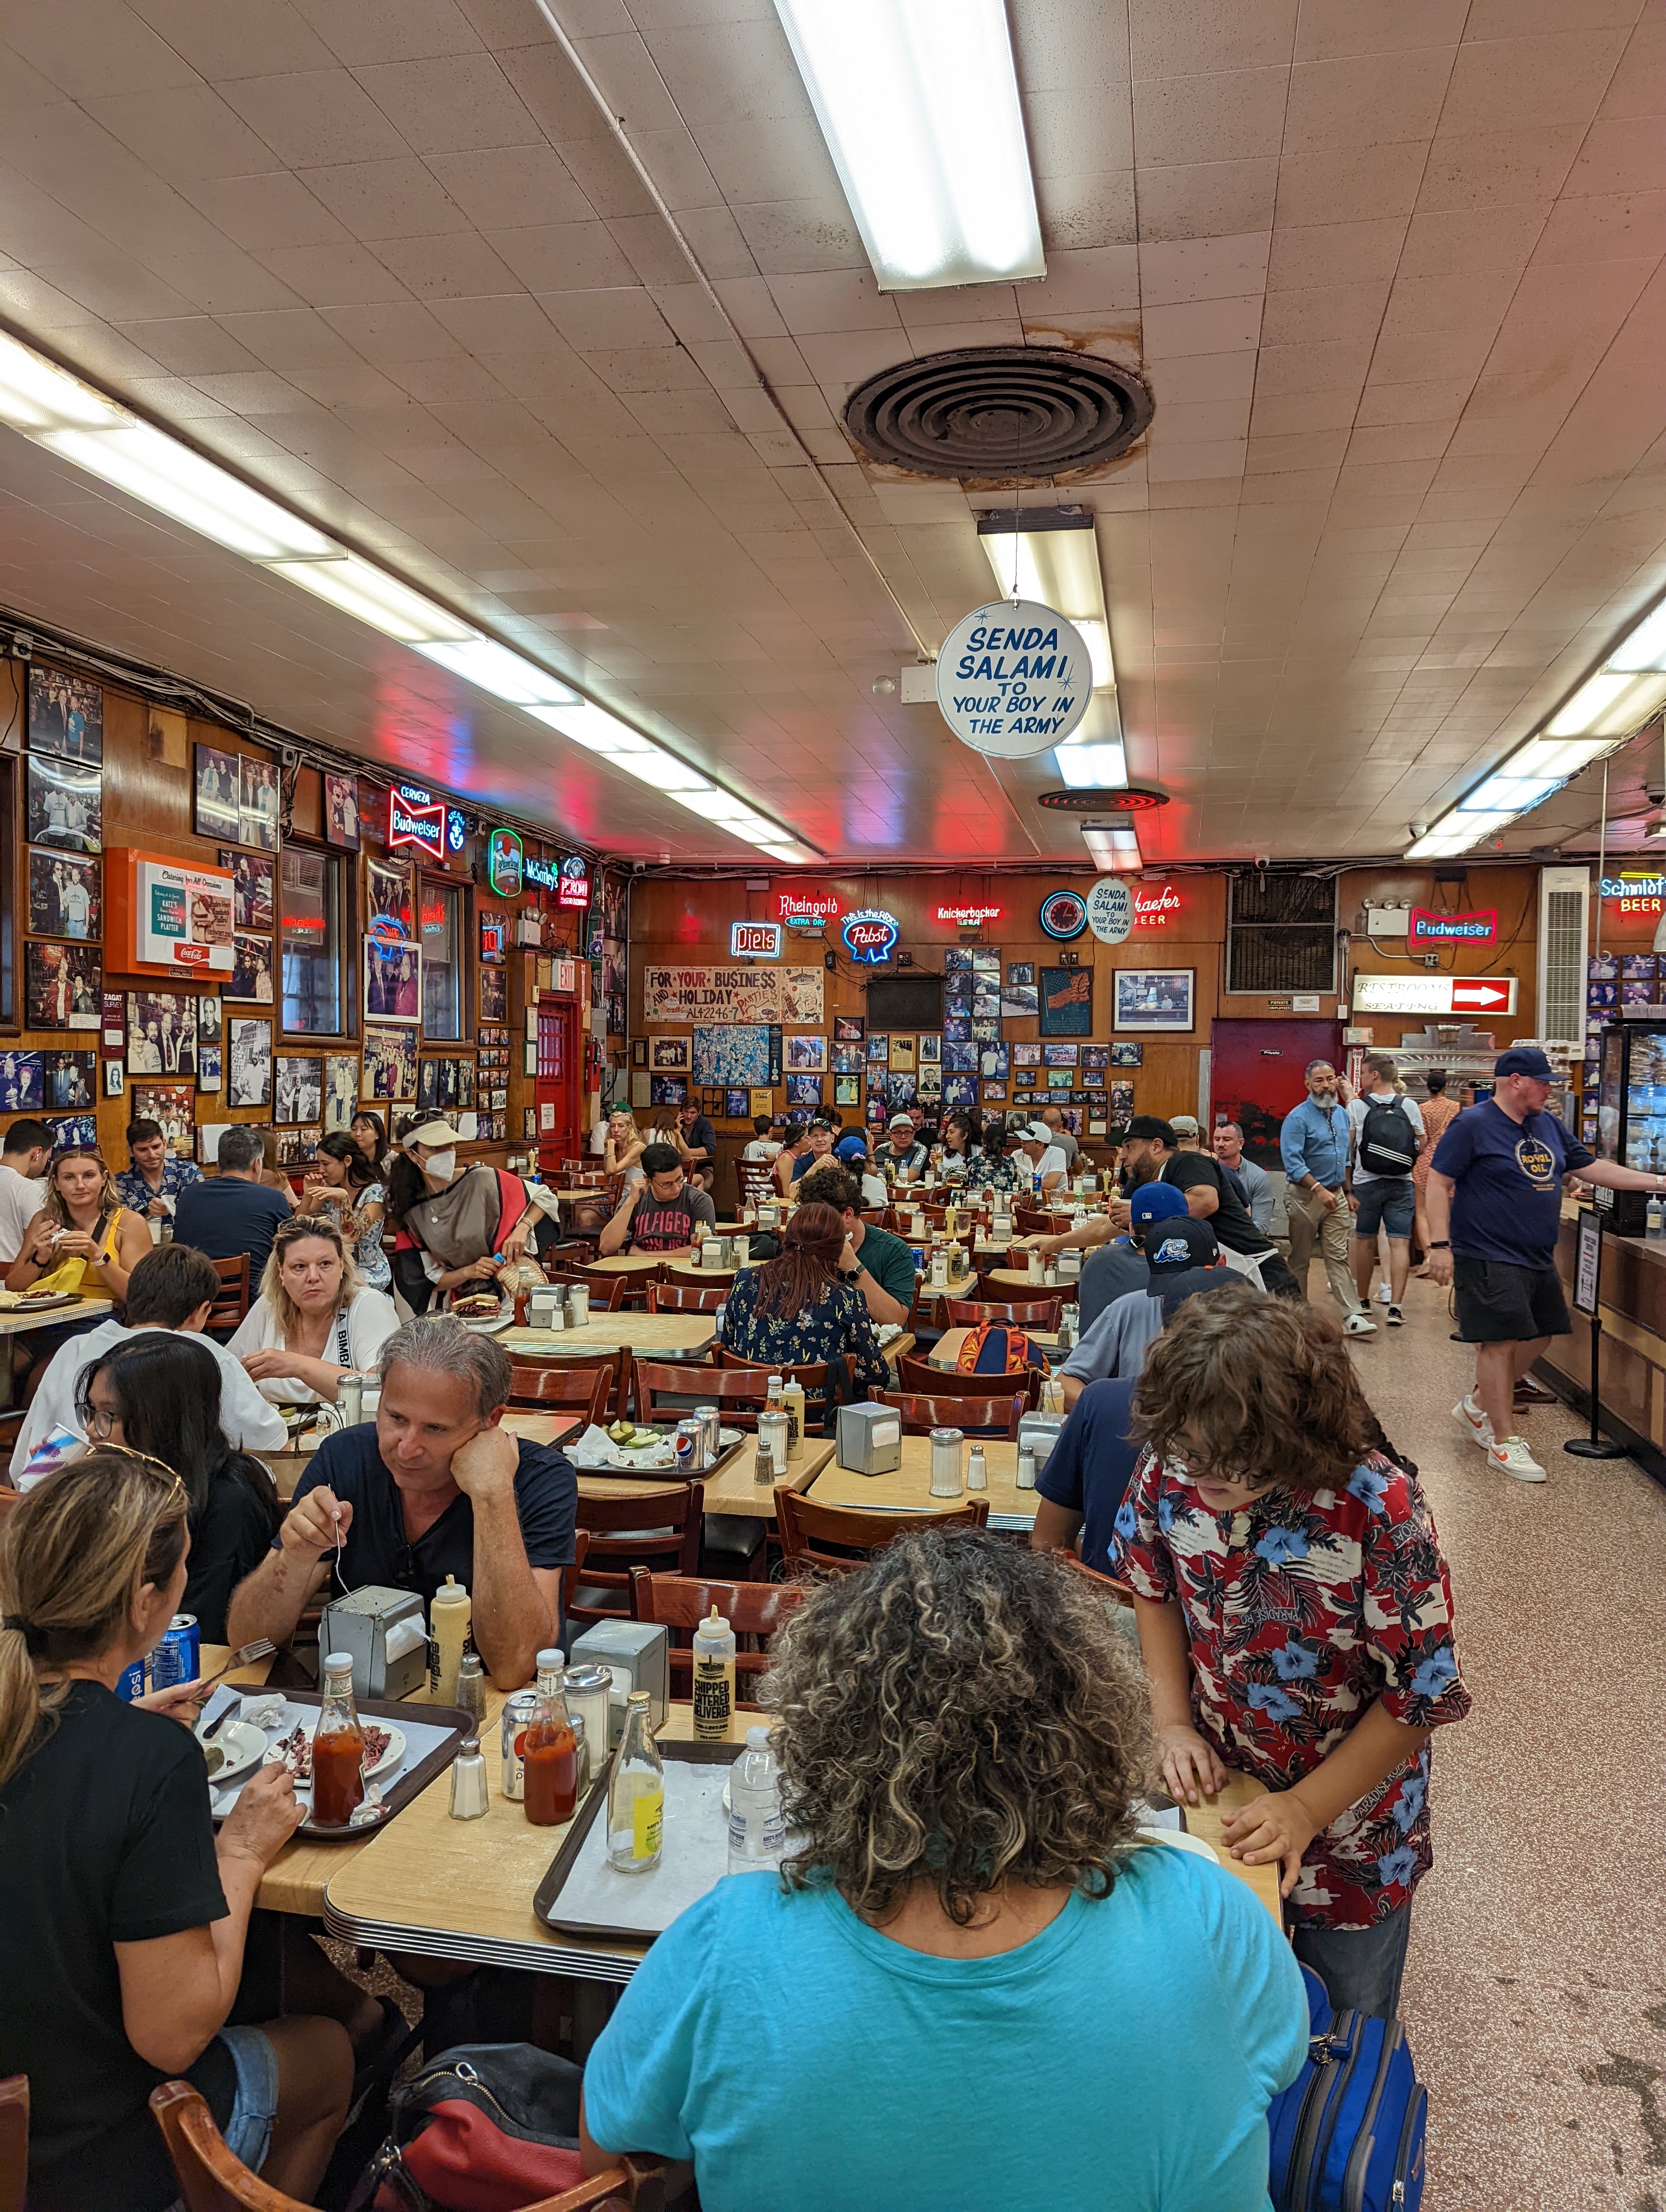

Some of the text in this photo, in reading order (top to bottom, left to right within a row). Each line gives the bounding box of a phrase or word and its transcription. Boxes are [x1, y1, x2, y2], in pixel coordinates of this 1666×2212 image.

[956, 655, 1068, 680] SALAMI
[997, 681, 1028, 697] TO
[953, 696, 1075, 713] YOUR BOY IN
[969, 716, 1066, 735] THE ARMY
[401, 786, 431, 805] CERVEZA
[393, 810, 440, 838] Budweiser
[526, 858, 559, 891] McSorley's
[560, 877, 588, 897] PERONI
[162, 900, 178, 909] KATZ'S
[779, 895, 838, 917] Rheingold
[1093, 899, 1128, 912] SALAMI
[1620, 898, 1661, 912] BEER
[157, 914, 182, 925] SANDWICH
[938, 906, 1000, 919] Knickerbocker
[1092, 916, 1107, 924] YOUR
[1134, 915, 1166, 925] EER
[161, 924, 180, 933] PLATTER
[790, 917, 826, 927] EXTRA DRY
[1416, 921, 1492, 936] Budweiser
[852, 925, 889, 944] Pabst
[1109, 927, 1128, 935] ARMY
[560, 964, 573, 989] EXIT
[650, 972, 673, 988] FOR
[677, 972, 707, 988] YOUR
[1357, 982, 1451, 994] RESTROOMS
[104, 993, 123, 1001] ZAGAT
[652, 988, 778, 1017] AND HOLIDAY PARTIES
[1521, 1154, 1552, 1163] ROYAL
[1530, 1163, 1548, 1173] OIL
[1254, 1609, 1299, 1623] PARADISE
[694, 1679, 730, 1695] SHIPPED
[694, 1690, 730, 1707] CATERED
[1354, 1780, 1391, 1819] PARADISE
